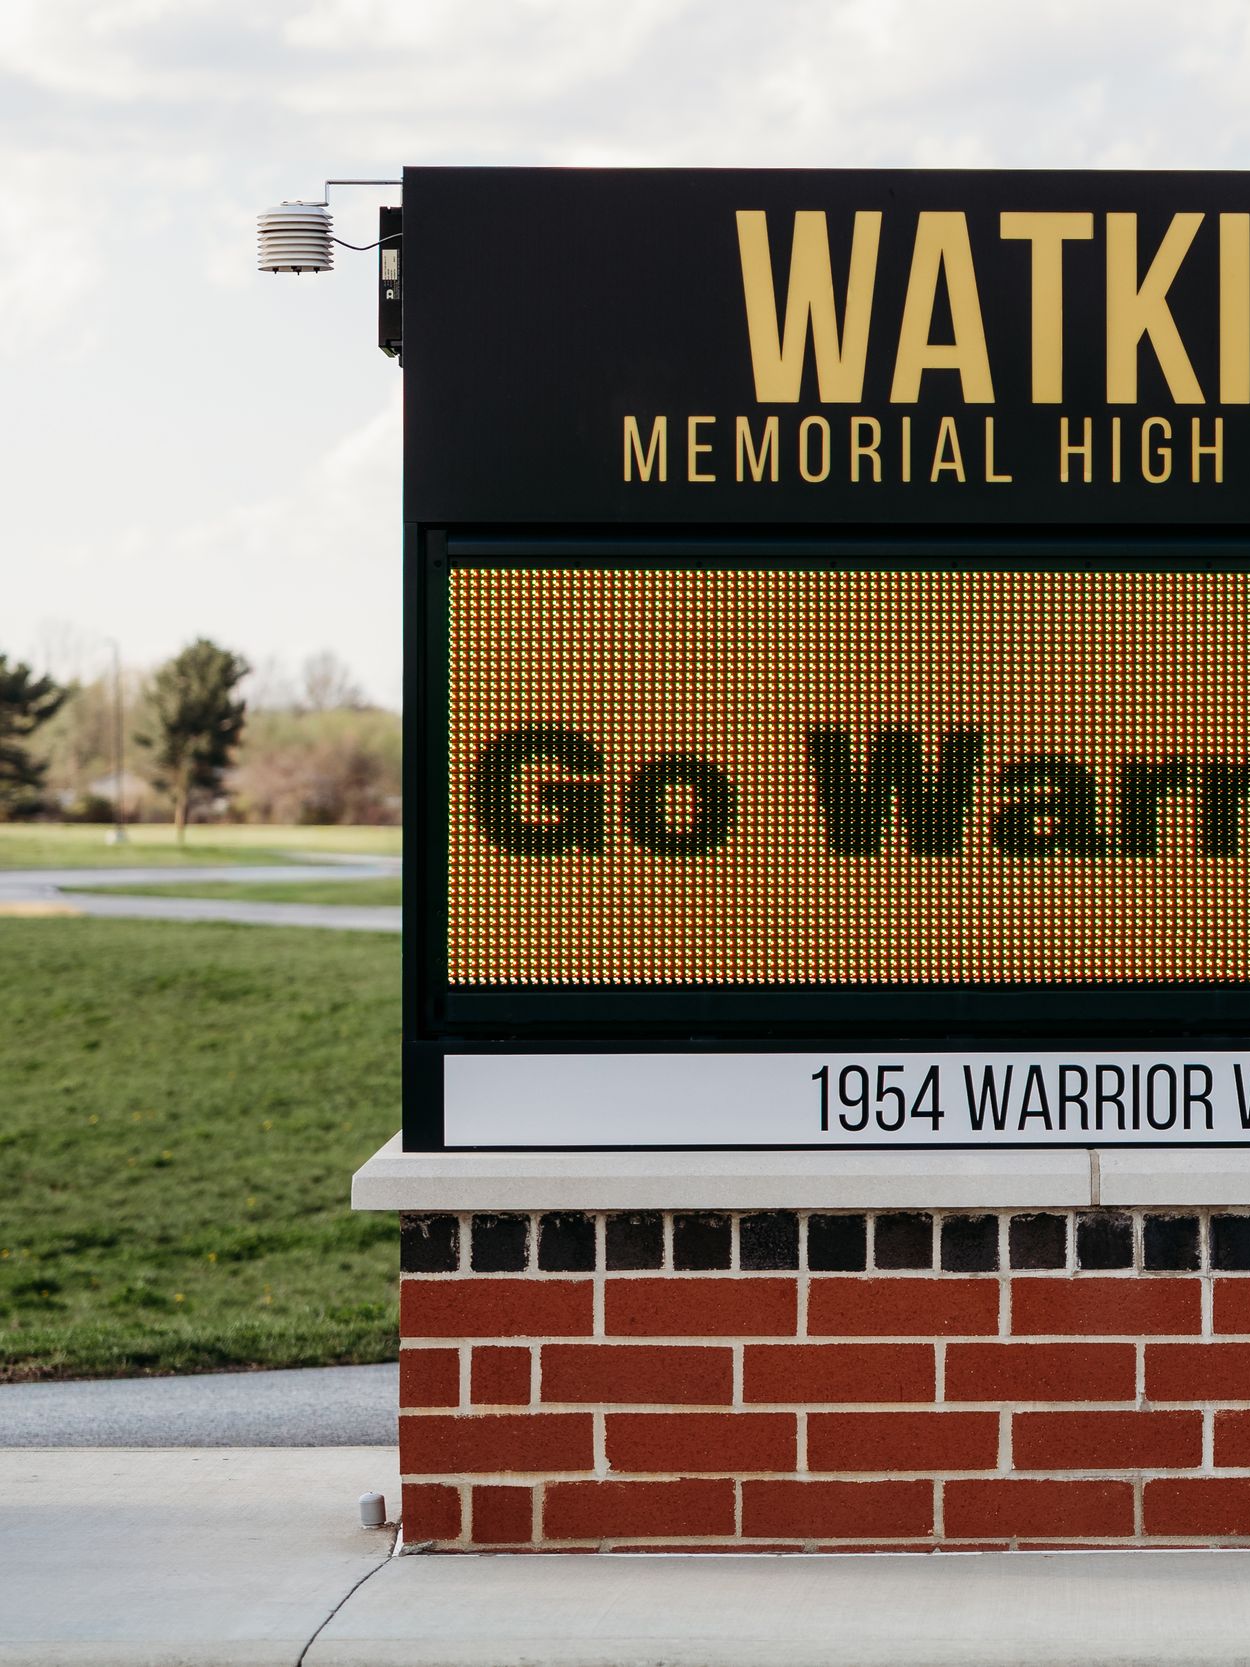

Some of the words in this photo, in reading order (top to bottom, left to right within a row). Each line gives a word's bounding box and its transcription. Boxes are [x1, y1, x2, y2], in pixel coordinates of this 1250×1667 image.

[623, 415, 1013, 484] MEMORIAL
[1060, 416, 1224, 485] HIGH
[473, 724, 735, 857] Go
[811, 1064, 945, 1132] 1954
[962, 1063, 1214, 1131] WARRIOR
